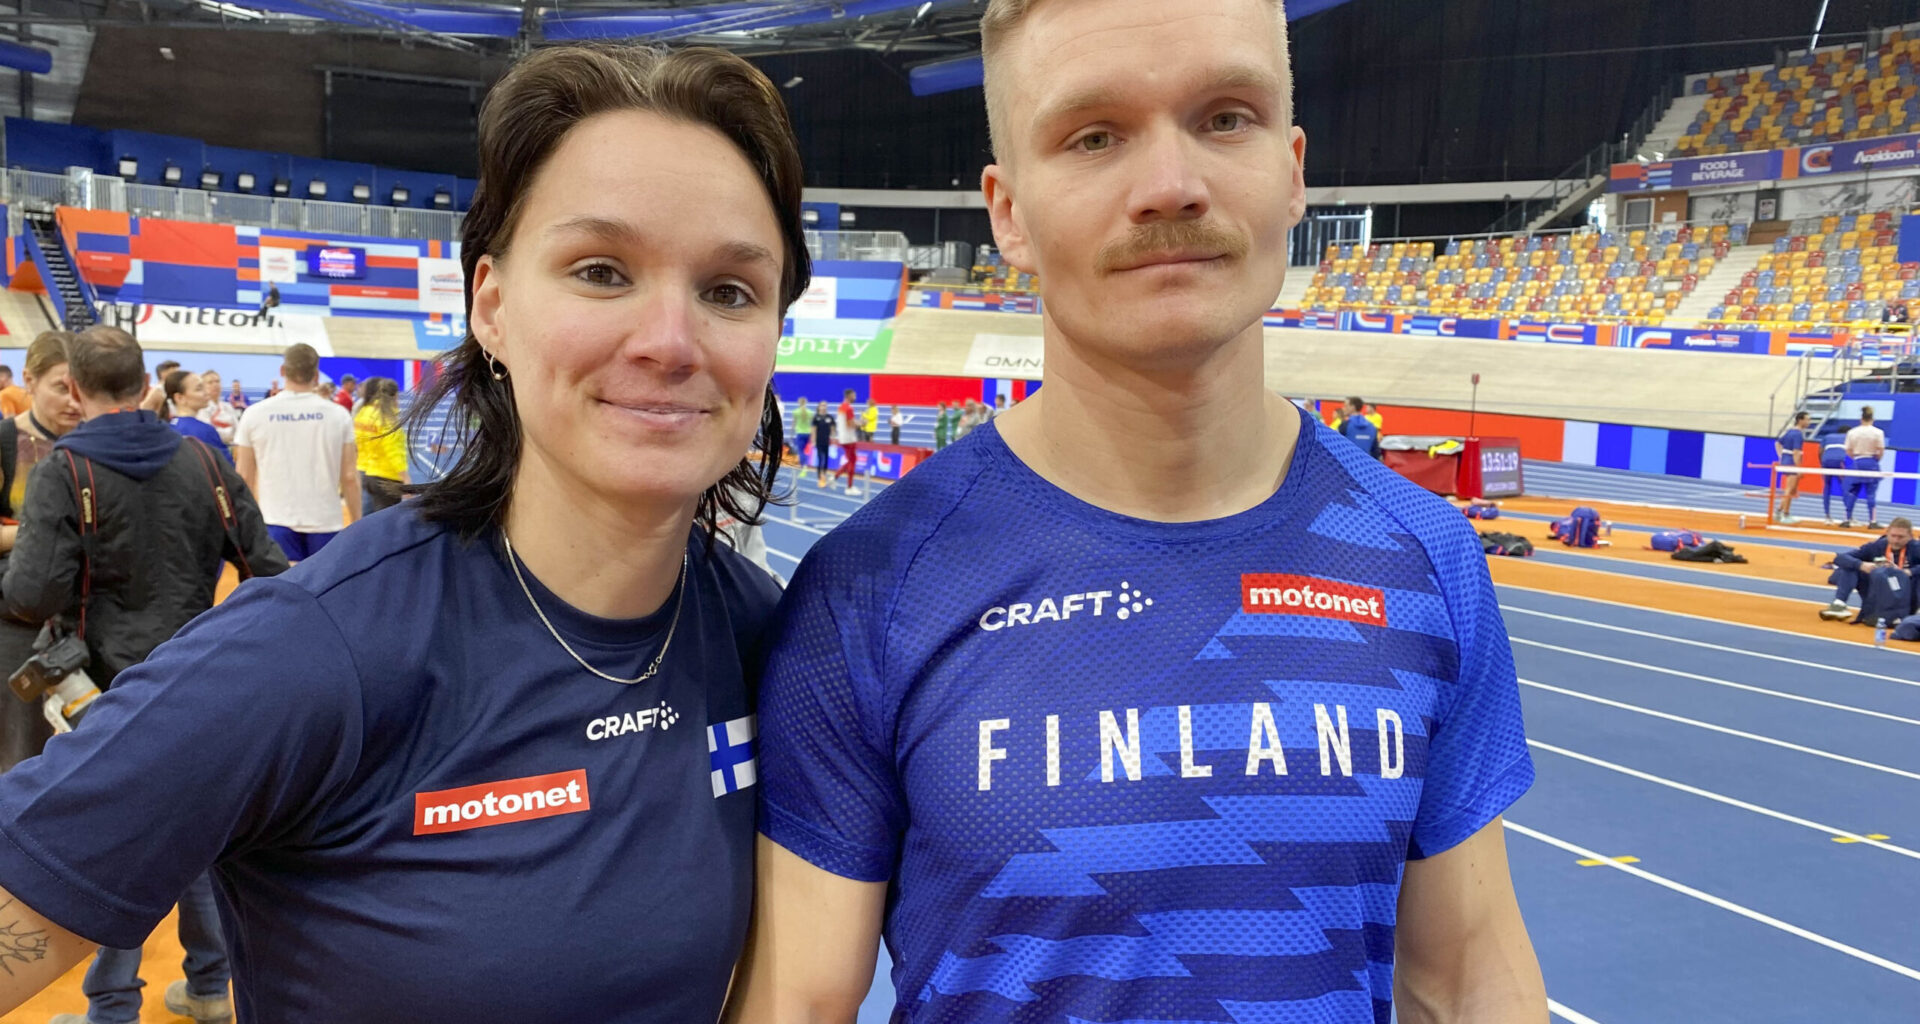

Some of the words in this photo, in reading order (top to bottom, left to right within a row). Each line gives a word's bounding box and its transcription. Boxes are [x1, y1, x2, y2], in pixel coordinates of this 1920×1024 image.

[1692, 168, 1744, 181] BEVERAGE
[1700, 161, 1728, 171] FOOD
[1729, 160, 1737, 168] &
[777, 336, 870, 360] gnify
[985, 356, 1043, 368] OMN
[269, 412, 324, 422] FINLAND
[979, 590, 1112, 631] CRAFT
[1249, 584, 1382, 619] motonet
[586, 707, 660, 741] CRAFT
[977, 702, 1405, 791] FINLAND
[423, 779, 582, 826] motonet
